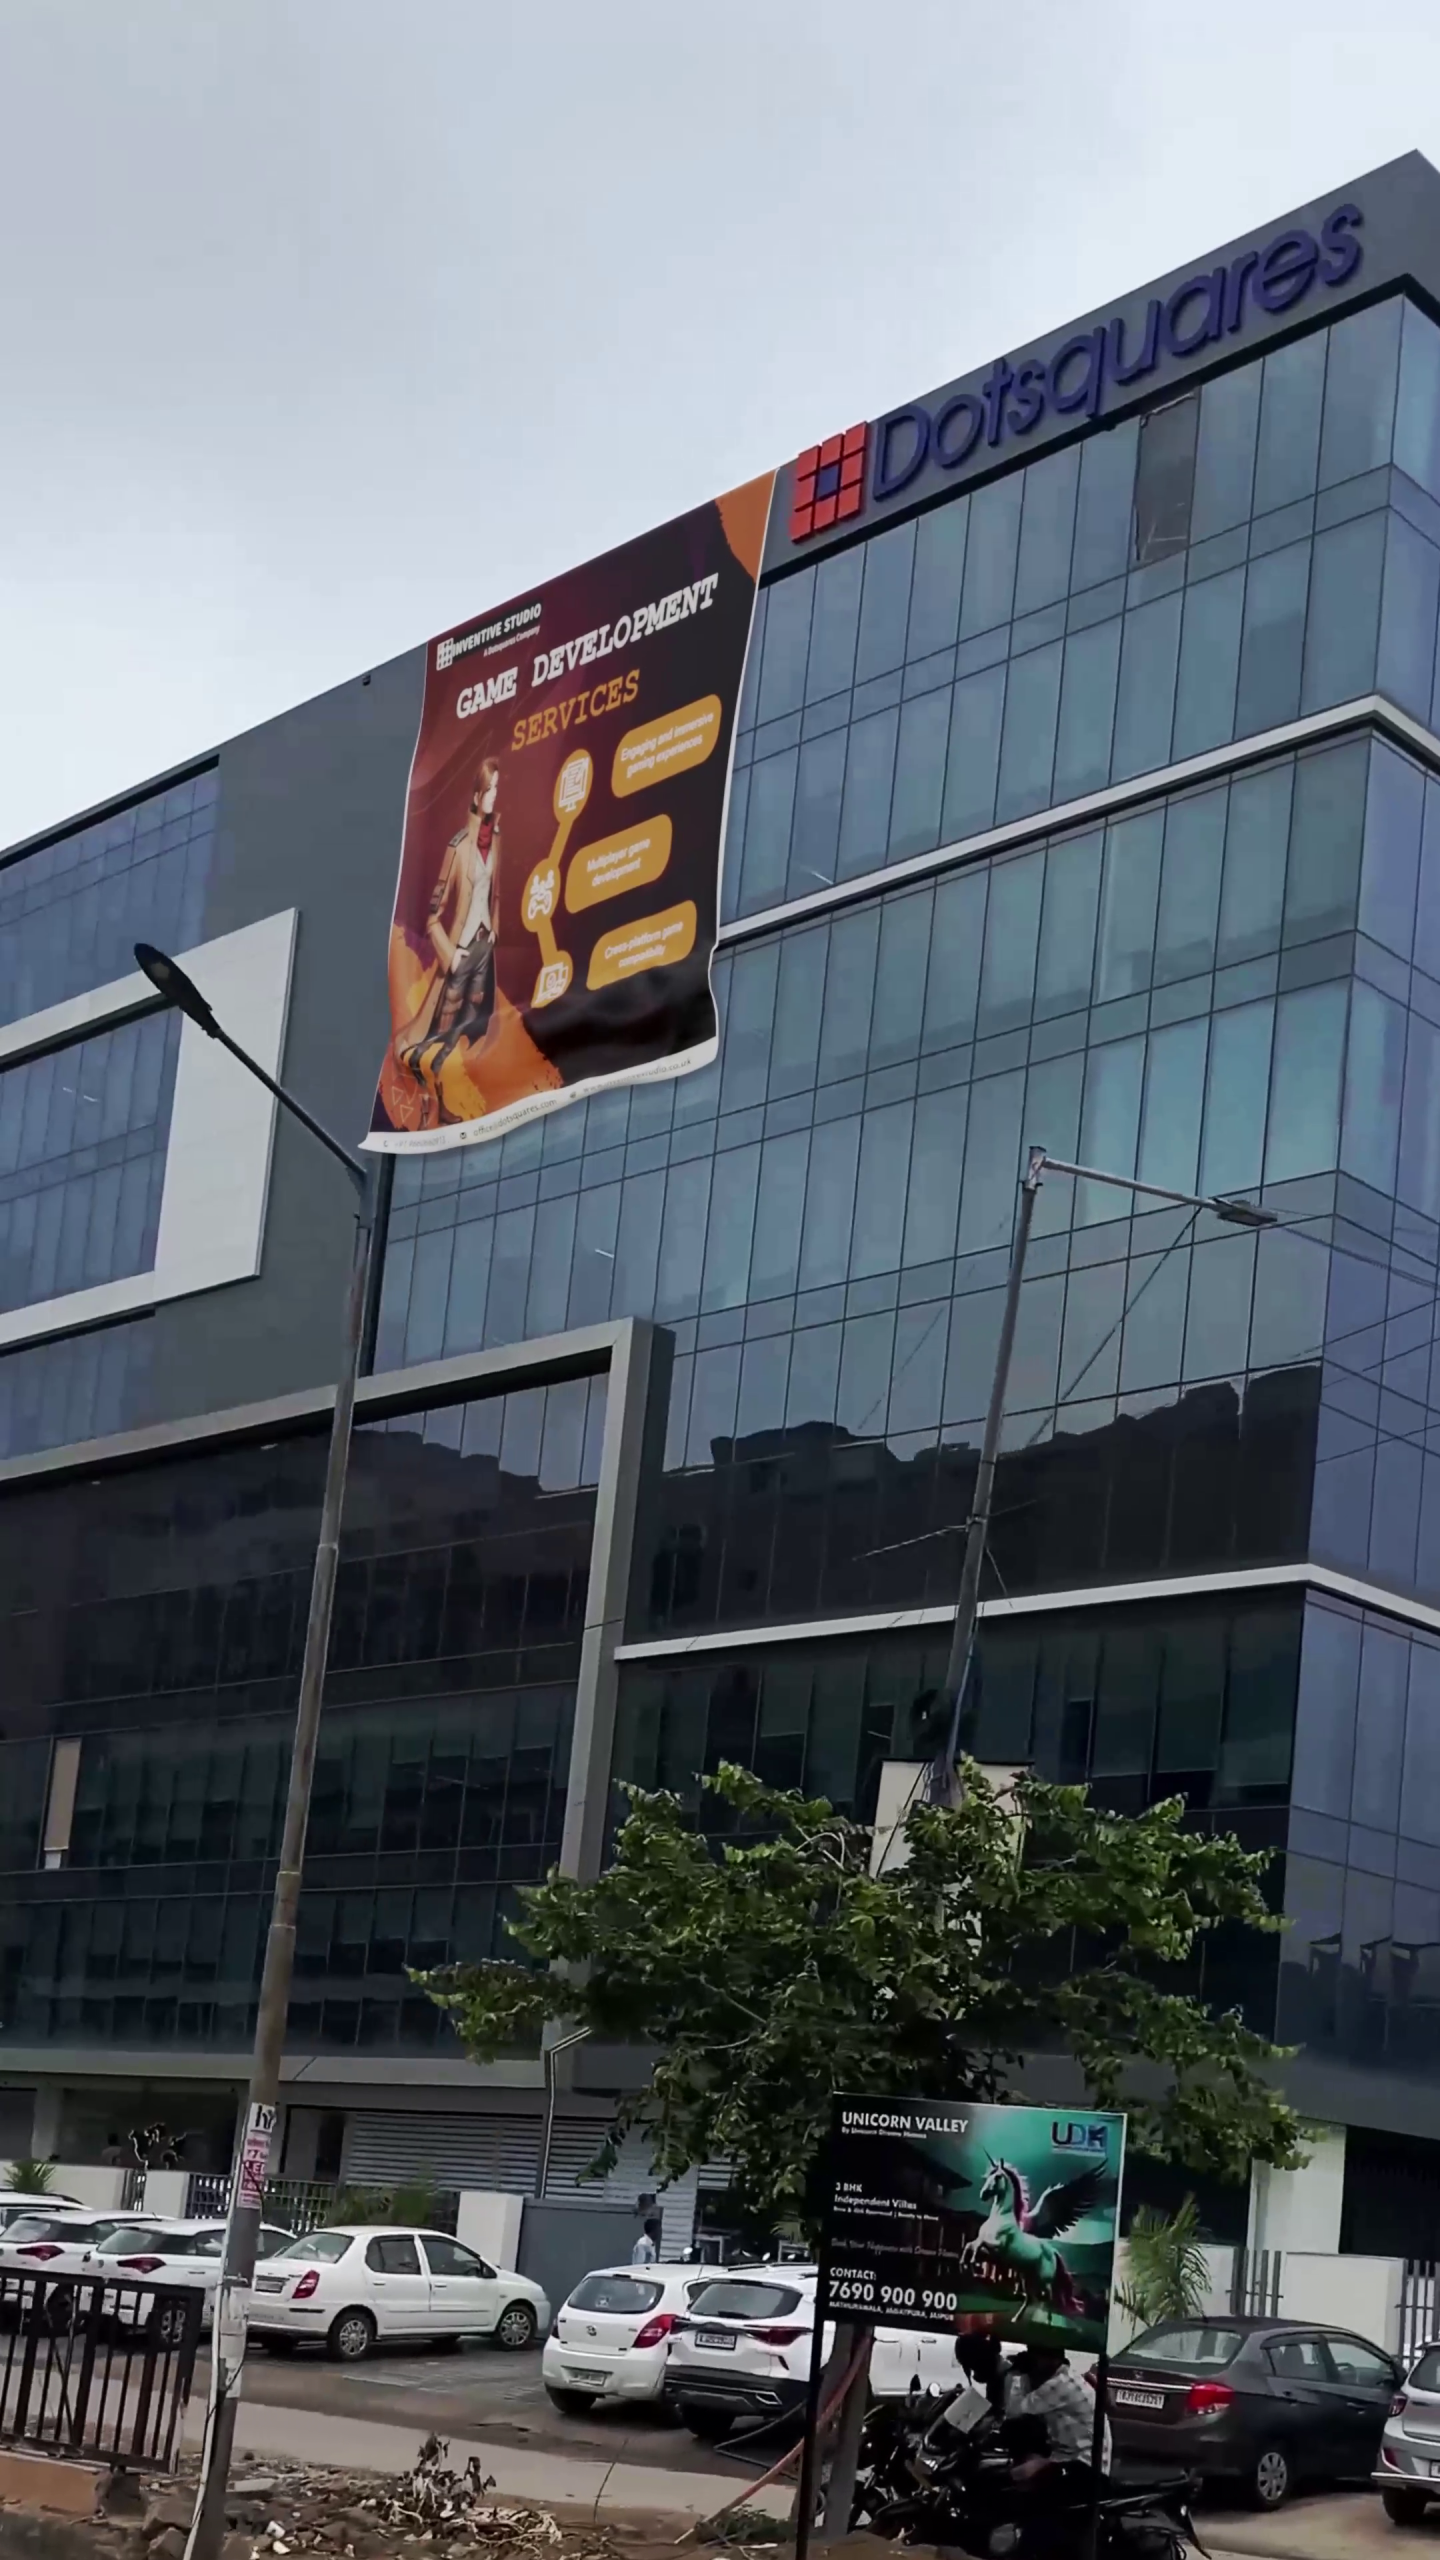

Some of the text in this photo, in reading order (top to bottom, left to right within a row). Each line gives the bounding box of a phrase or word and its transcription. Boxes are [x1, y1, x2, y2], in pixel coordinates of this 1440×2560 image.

[872, 203, 1364, 501] Dotsquares
[452, 603, 542, 658] INVENTIVE STUDIO
[456, 573, 719, 719] GAME DEVELOPMENT
[511, 669, 640, 751] SERVICES
[621, 738, 657, 762] Engaging
[657, 727, 673, 746] and
[842, 2111, 969, 2133] UNICORN VALLEY
[834, 2194, 917, 2209] Independent Villas
[835, 2182, 863, 2193] 3 BHK
[830, 2267, 877, 2280] CONTACT:
[829, 2280, 958, 2311] 7690 900 900
